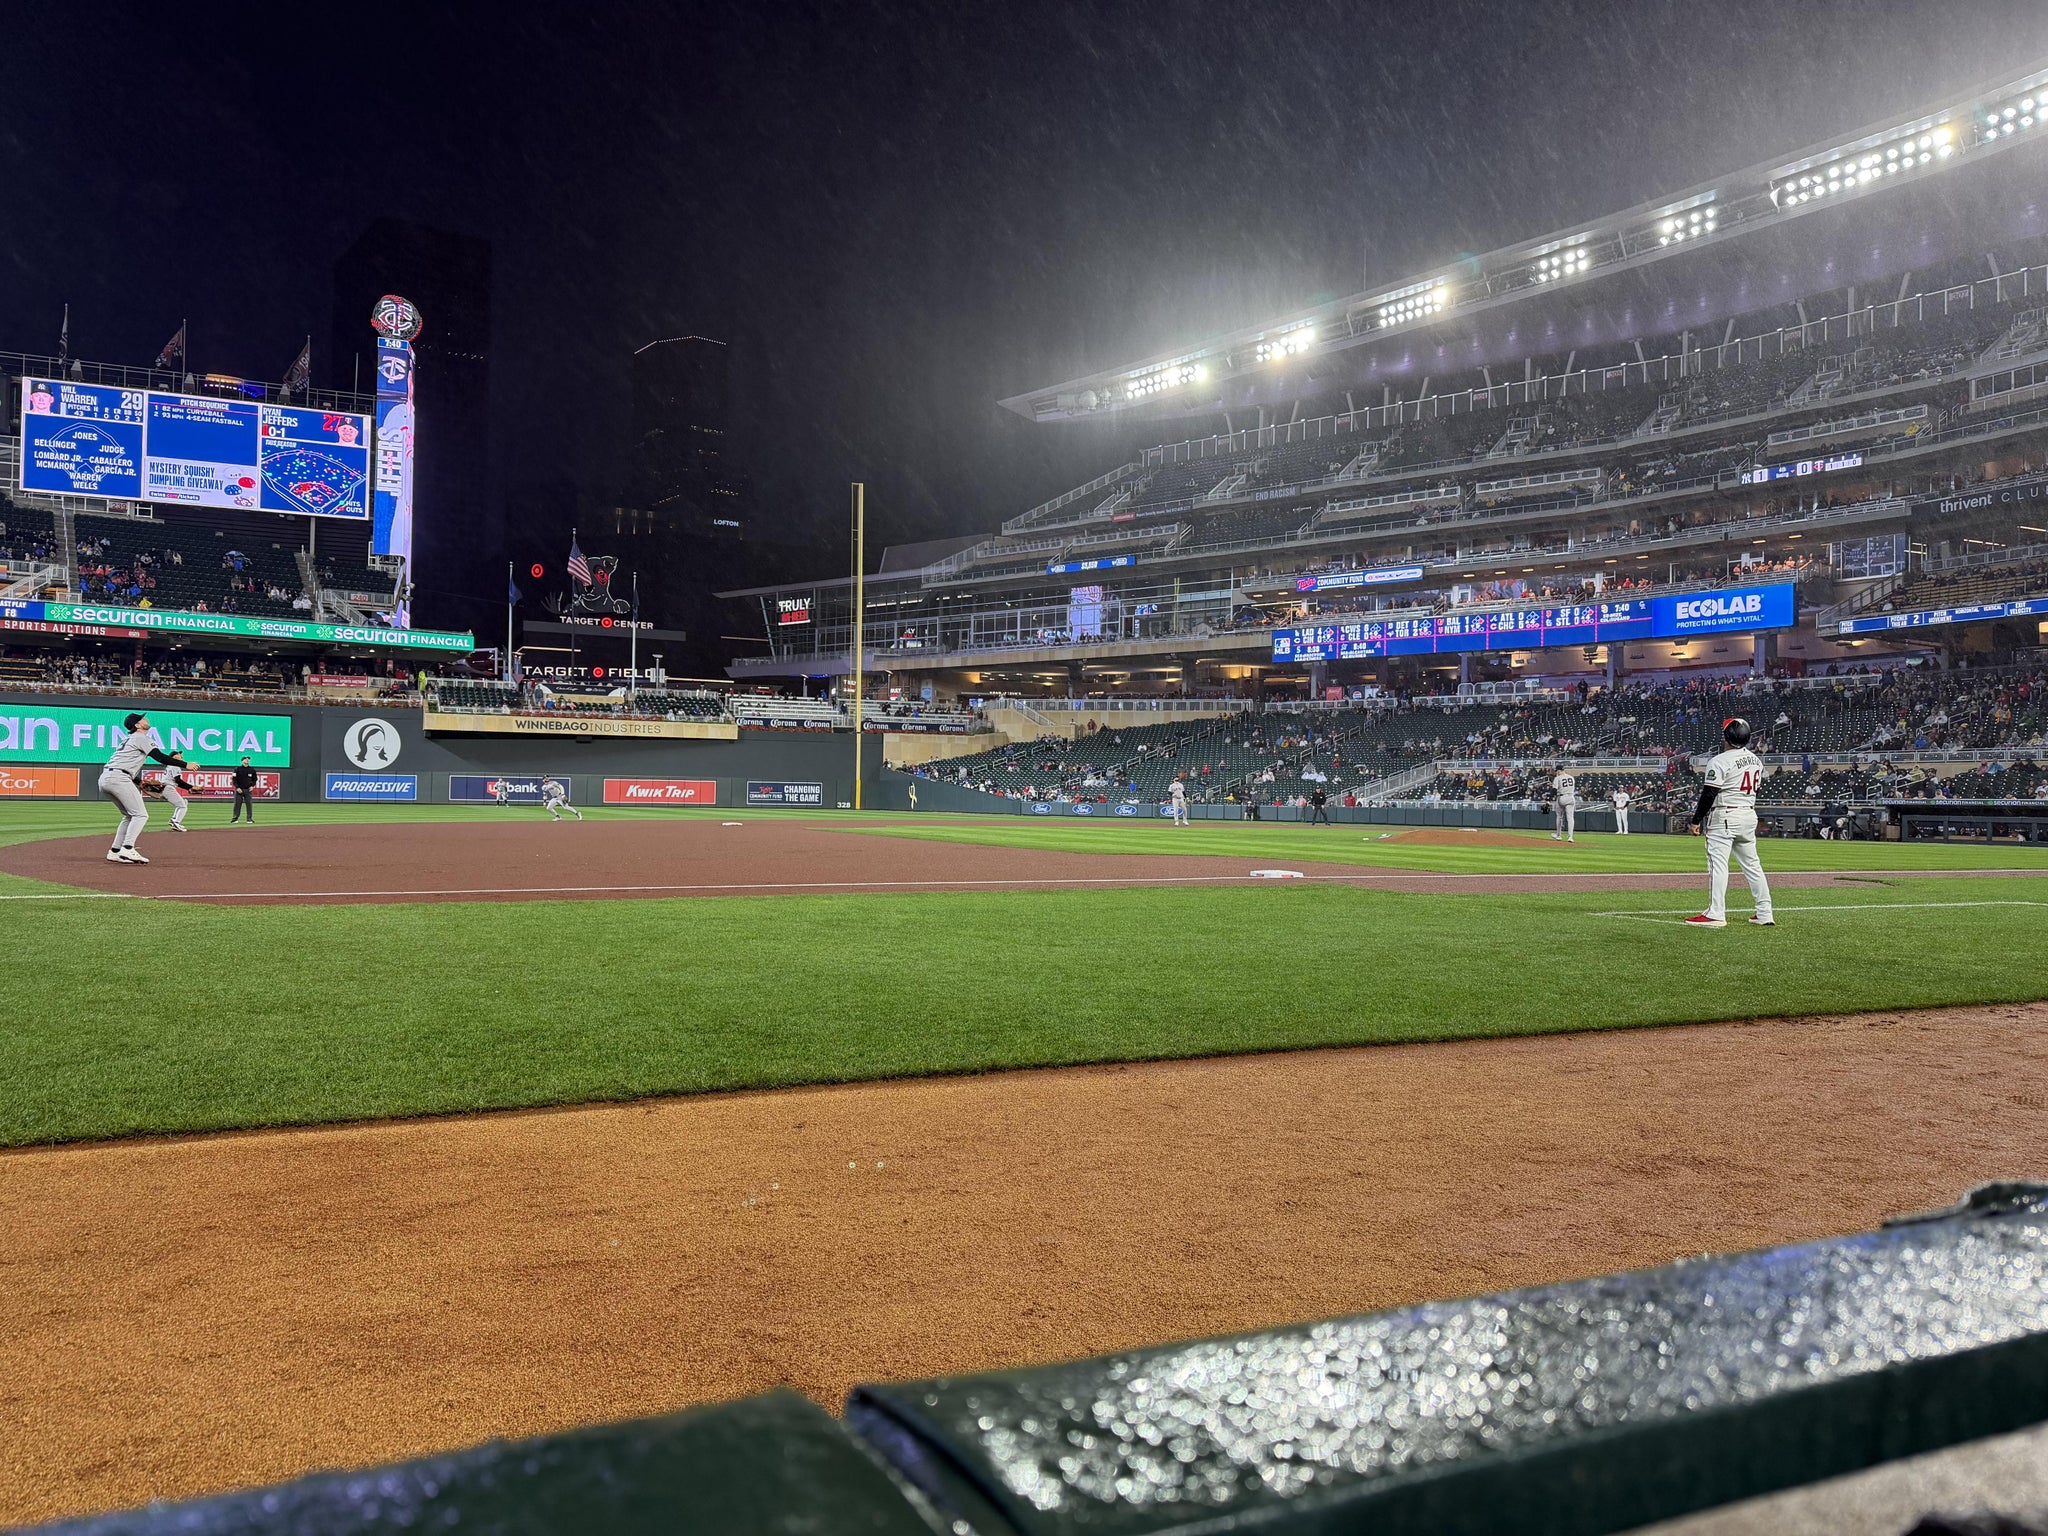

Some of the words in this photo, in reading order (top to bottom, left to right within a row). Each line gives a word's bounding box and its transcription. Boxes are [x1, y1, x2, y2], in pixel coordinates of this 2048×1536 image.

[385, 340, 401, 348] 7:40
[61, 385, 76, 394] WILL
[61, 393, 97, 406] WARREN
[121, 392, 143, 410] 29
[181, 399, 199, 407] PITCH
[199, 400, 229, 410] SEQUENCE
[68, 403, 91, 412] PITCHES
[263, 407, 281, 416] RYAN
[187, 408, 224, 418] CURVEBALL
[186, 415, 210, 423] 4-SEAM
[212, 418, 244, 426] FASTBALL
[262, 415, 298, 427] JEFFERS
[323, 414, 344, 431] 27
[72, 432, 98, 441] JONES
[268, 426, 285, 438] 0-1
[34, 439, 76, 450] BELLINGER
[277, 440, 297, 448] SEASON
[99, 445, 125, 454] JUDGE
[34, 451, 69, 461] LOMBARD
[71, 454, 83, 463] JR.
[89, 456, 133, 467] CABALLERO
[377, 427, 403, 497] JEFFERS
[36, 460, 76, 471] MCMAHON
[94, 465, 122, 475] GARCÍA
[124, 468, 136, 476] JR.
[149, 462, 181, 475] MYSTERY
[184, 465, 215, 478] SQUISHY
[1801, 463, 1807, 474] 0
[70, 472, 102, 482] WARREN
[149, 474, 185, 487] DUMPLING
[187, 477, 224, 490] GIVEAWAY
[73, 481, 98, 490] WELLS
[1940, 493, 1993, 513] thrivent
[2001, 485, 2048, 503] CLU
[713, 519, 739, 527] LOFTON
[1297, 577, 1317, 591] Twins
[1317, 576, 1349, 586] COMMUNITY
[1349, 575, 1363, 583] FUND
[778, 597, 811, 612] TRULY
[1615, 604, 1629, 612] 7:40
[1676, 594, 1761, 619] ECOLAB
[1983, 604, 2002, 612] VERTICAL
[5, 608, 17, 617] F8
[1561, 608, 1570, 617] SF
[1574, 608, 1579, 616] 0
[2010, 607, 2032, 615] VELOCITY
[72, 607, 162, 626] securian
[165, 616, 235, 630] FINANCIAL
[1446, 617, 1460, 626] BAL
[1465, 616, 1469, 624] 1
[1500, 613, 1514, 621] ATL
[1518, 612, 1524, 621] 0
[1556, 617, 1570, 626] STL
[1574, 616, 1579, 625] 0
[1913, 614, 1919, 624] 2
[4, 620, 47, 631] SPORTS
[53, 624, 106, 635] AUCTIONS
[261, 622, 306, 633] securian
[560, 615, 600, 626] TARGET
[614, 619, 654, 630] CENTER
[1396, 621, 1409, 630] DET
[1413, 620, 1418, 628] 0
[1498, 622, 1514, 631] CHC
[1676, 620, 1717, 628] PROTECTING
[1717, 617, 1742, 625] WHAT'S
[1302, 628, 1314, 637] LAD
[1317, 627, 1322, 635] 4
[1345, 625, 1360, 633] CWS
[1395, 629, 1409, 637] TOR
[1413, 628, 1418, 636] 2
[1444, 625, 1460, 634] NYM
[1465, 624, 1469, 632] 1
[334, 627, 409, 644] securian
[411, 635, 470, 648] FINANCIAL
[1317, 635, 1322, 643] 0
[1348, 633, 1360, 641] CLE
[1364, 632, 1369, 640] 0
[1274, 646, 1291, 655] MLB
[522, 666, 588, 677] TARGET
[608, 668, 653, 678] FIELD
[515, 719, 589, 732] WINNEBAGO
[590, 723, 662, 734] INDUSTRIES
[736, 718, 763, 727] Corona
[770, 719, 797, 728] Corona
[804, 719, 830, 728] Corona
[863, 721, 889, 730] Corona
[901, 723, 927, 731] Corona
[939, 724, 964, 733] Corona
[73, 724, 282, 753] FINANCIAL
[214, 774, 233, 788] LIKE
[1562, 777, 1574, 788] 29
[1740, 769, 1760, 795] 46
[331, 781, 412, 793] PROGRESSIVE
[507, 781, 537, 793] bank
[784, 785, 820, 794] CHANGING
[785, 794, 799, 802] THE
[799, 794, 819, 802] GAME
[1034, 804, 1049, 814] Ford
[1075, 804, 1091, 814] Ford
[1117, 805, 1134, 815] Ford
